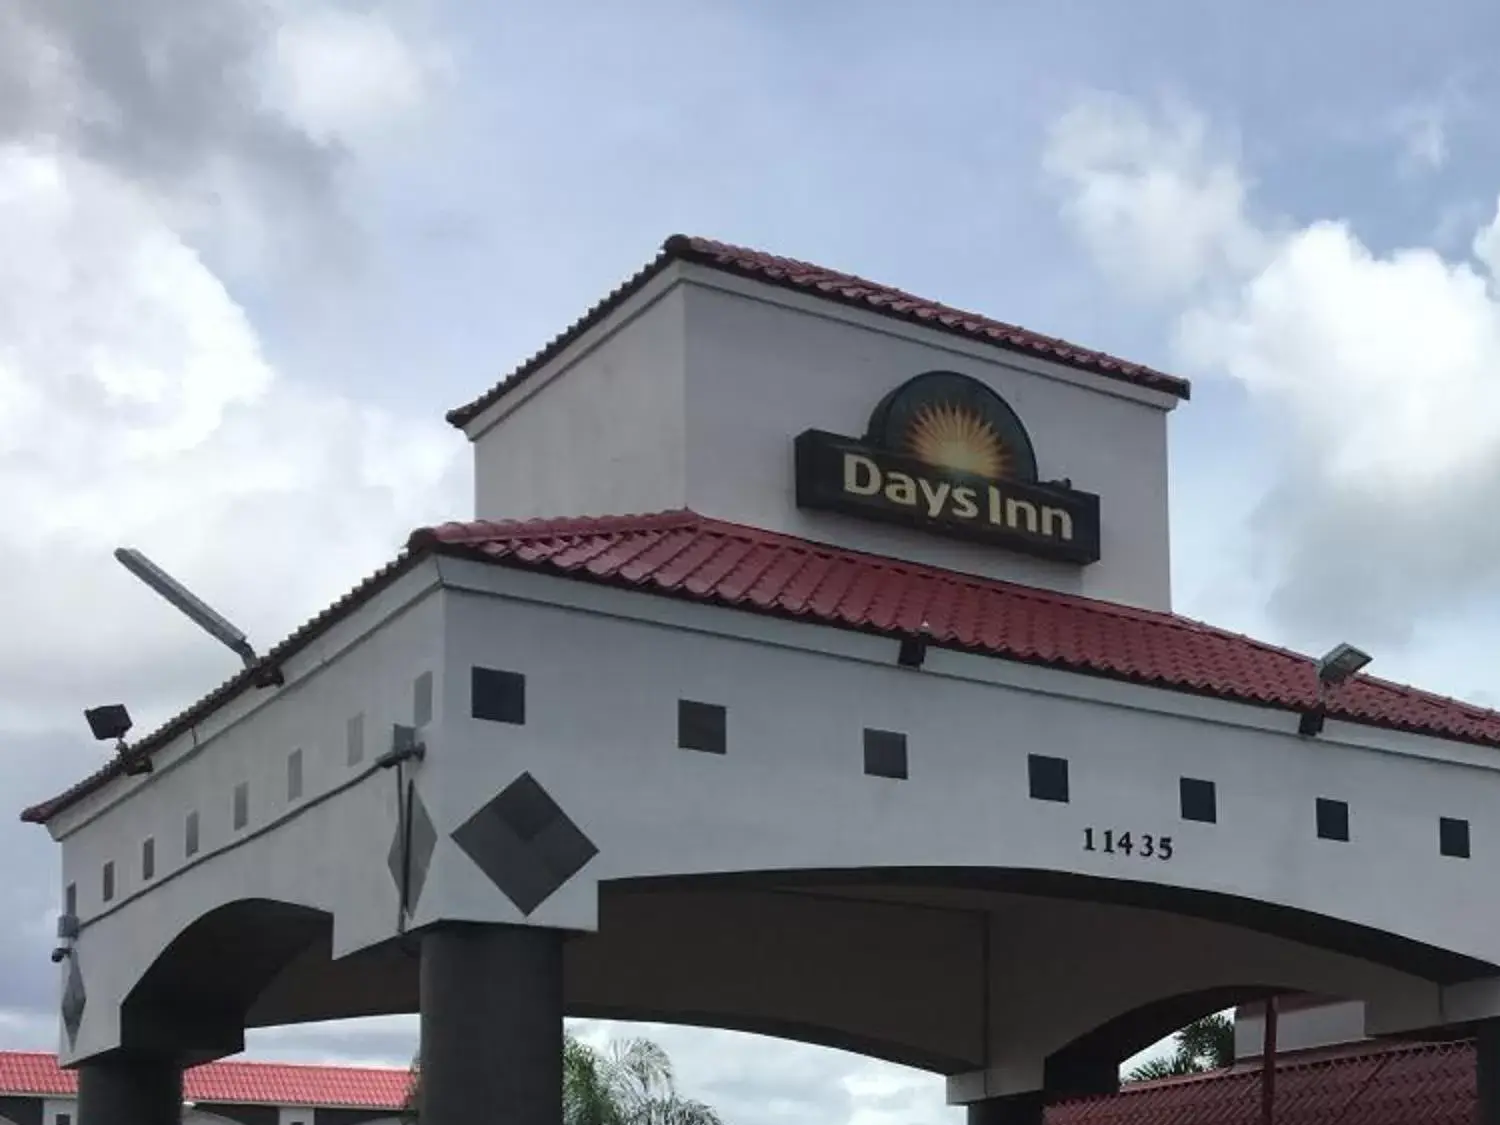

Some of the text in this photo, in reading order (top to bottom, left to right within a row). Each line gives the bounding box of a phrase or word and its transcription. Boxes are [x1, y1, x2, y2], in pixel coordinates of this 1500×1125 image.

[843, 453, 1074, 541] Days Inn
[1083, 827, 1174, 861] 11435
